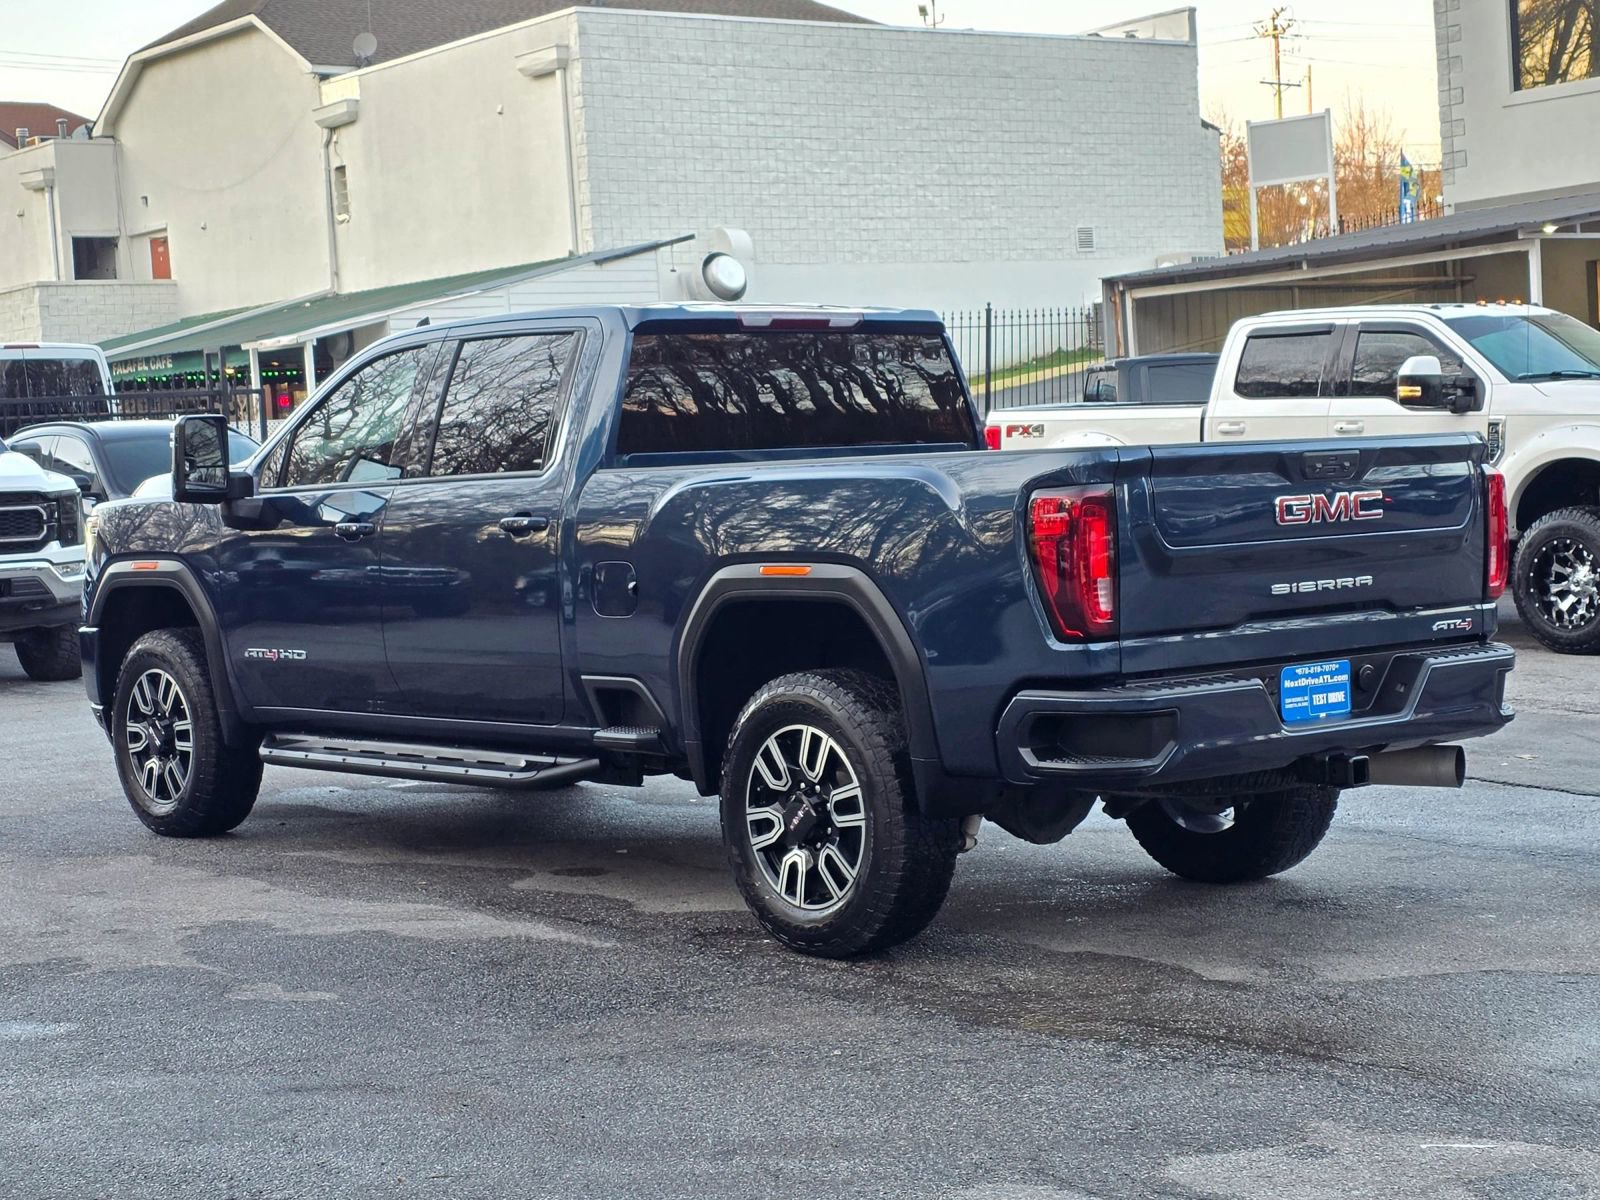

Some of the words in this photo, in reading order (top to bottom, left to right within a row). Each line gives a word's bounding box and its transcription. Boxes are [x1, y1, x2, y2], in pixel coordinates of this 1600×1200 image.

[112, 358, 148, 375] FALAFEL
[149, 355, 173, 370] CAFE
[1006, 424, 1045, 438] FX4
[1274, 490, 1384, 526] GMC
[1271, 575, 1373, 595] SIERRA
[1432, 617, 1473, 631] AT4
[1284, 674, 1349, 688] NextDriveATL.com
[1312, 693, 1327, 706] TEST
[1327, 691, 1346, 704] DRIVE
